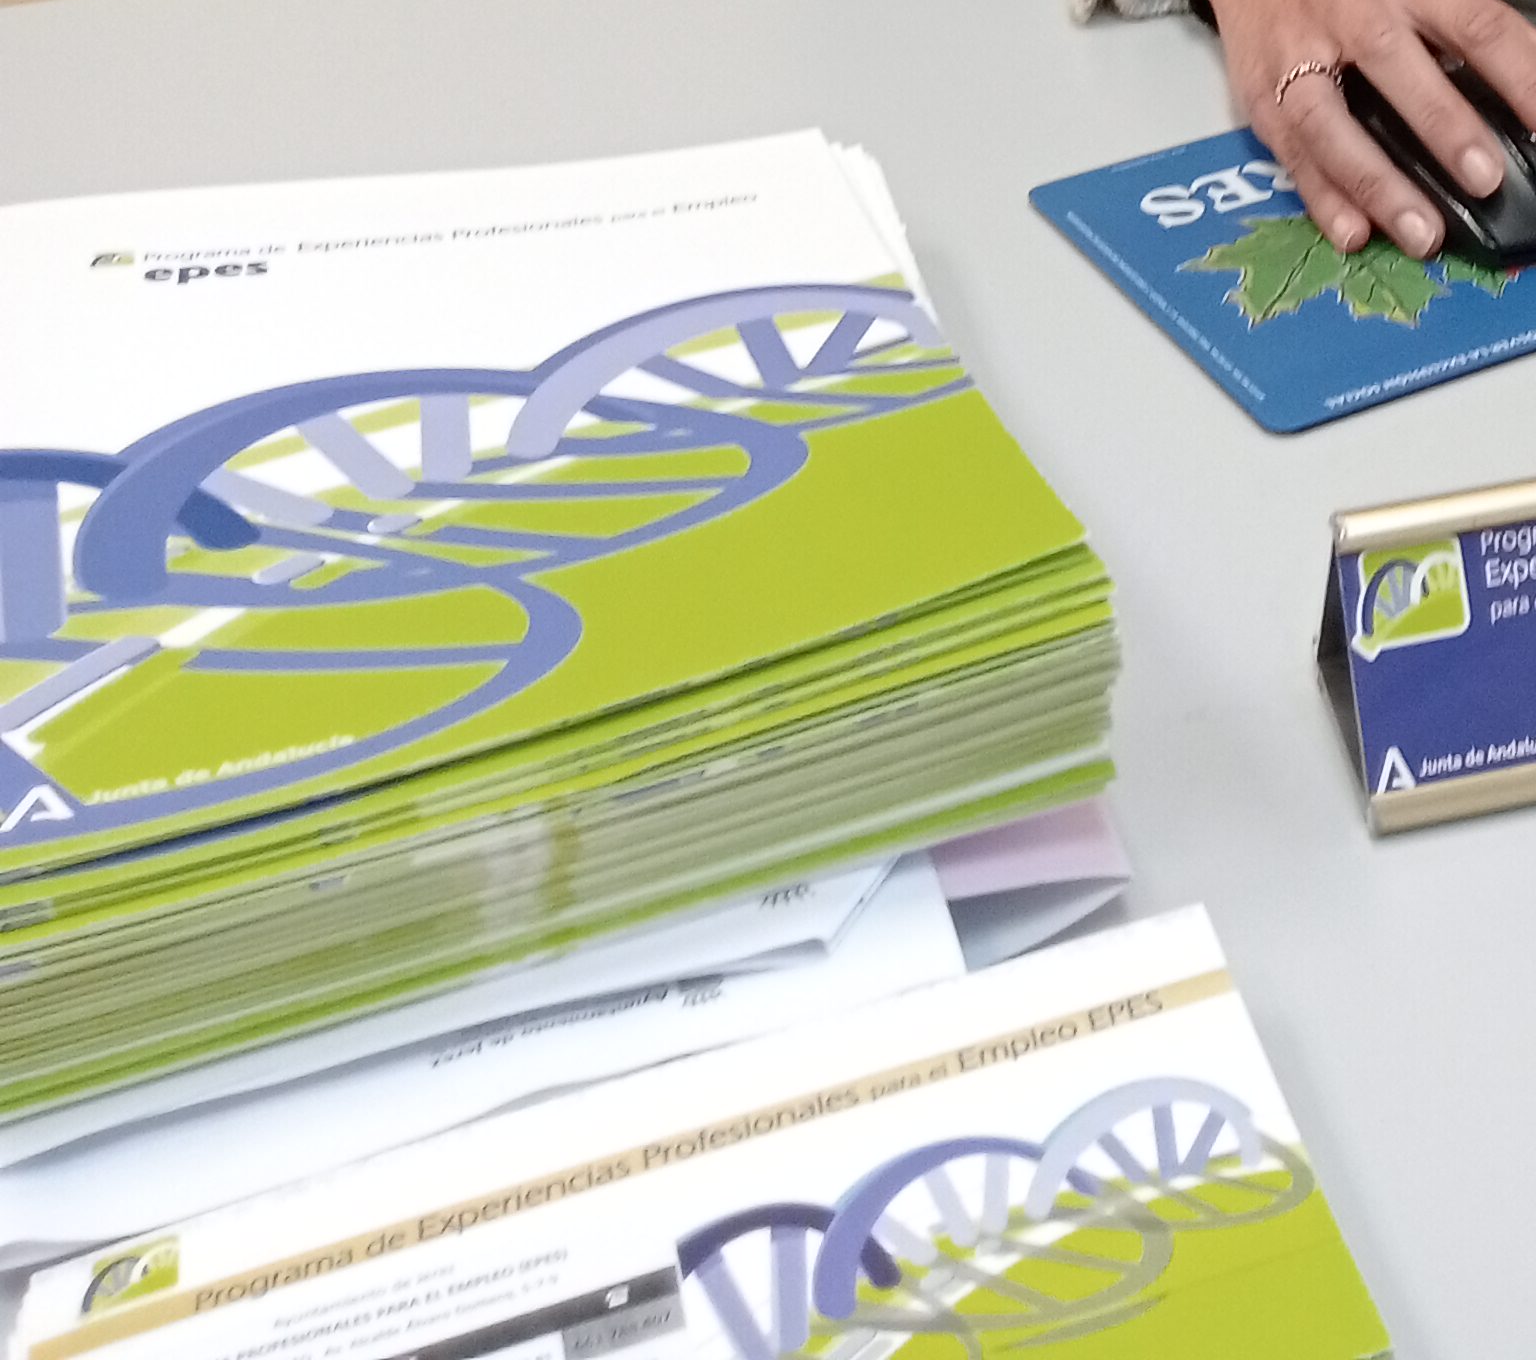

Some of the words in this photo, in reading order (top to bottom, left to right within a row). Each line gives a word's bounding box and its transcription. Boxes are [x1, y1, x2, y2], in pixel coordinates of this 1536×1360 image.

[298, 232, 443, 254] Experiencias
[452, 215, 602, 240] Profesionales
[673, 192, 757, 213] Empleo
[144, 261, 268, 285] epes
[1489, 594, 1531, 624] para
[1419, 753, 1463, 778] Junta
[1465, 745, 1485, 768] de
[88, 776, 169, 805] Junta
[174, 768, 212, 787] de
[193, 1249, 354, 1312] Programa
[366, 1232, 405, 1257] de
[416, 1161, 631, 1242] Experiencias
[641, 1086, 861, 1176] Profesionales
[869, 1069, 923, 1101] para
[928, 1062, 948, 1082] el
[956, 1017, 1079, 1073] Empleo
[1088, 991, 1165, 1033] EPES
